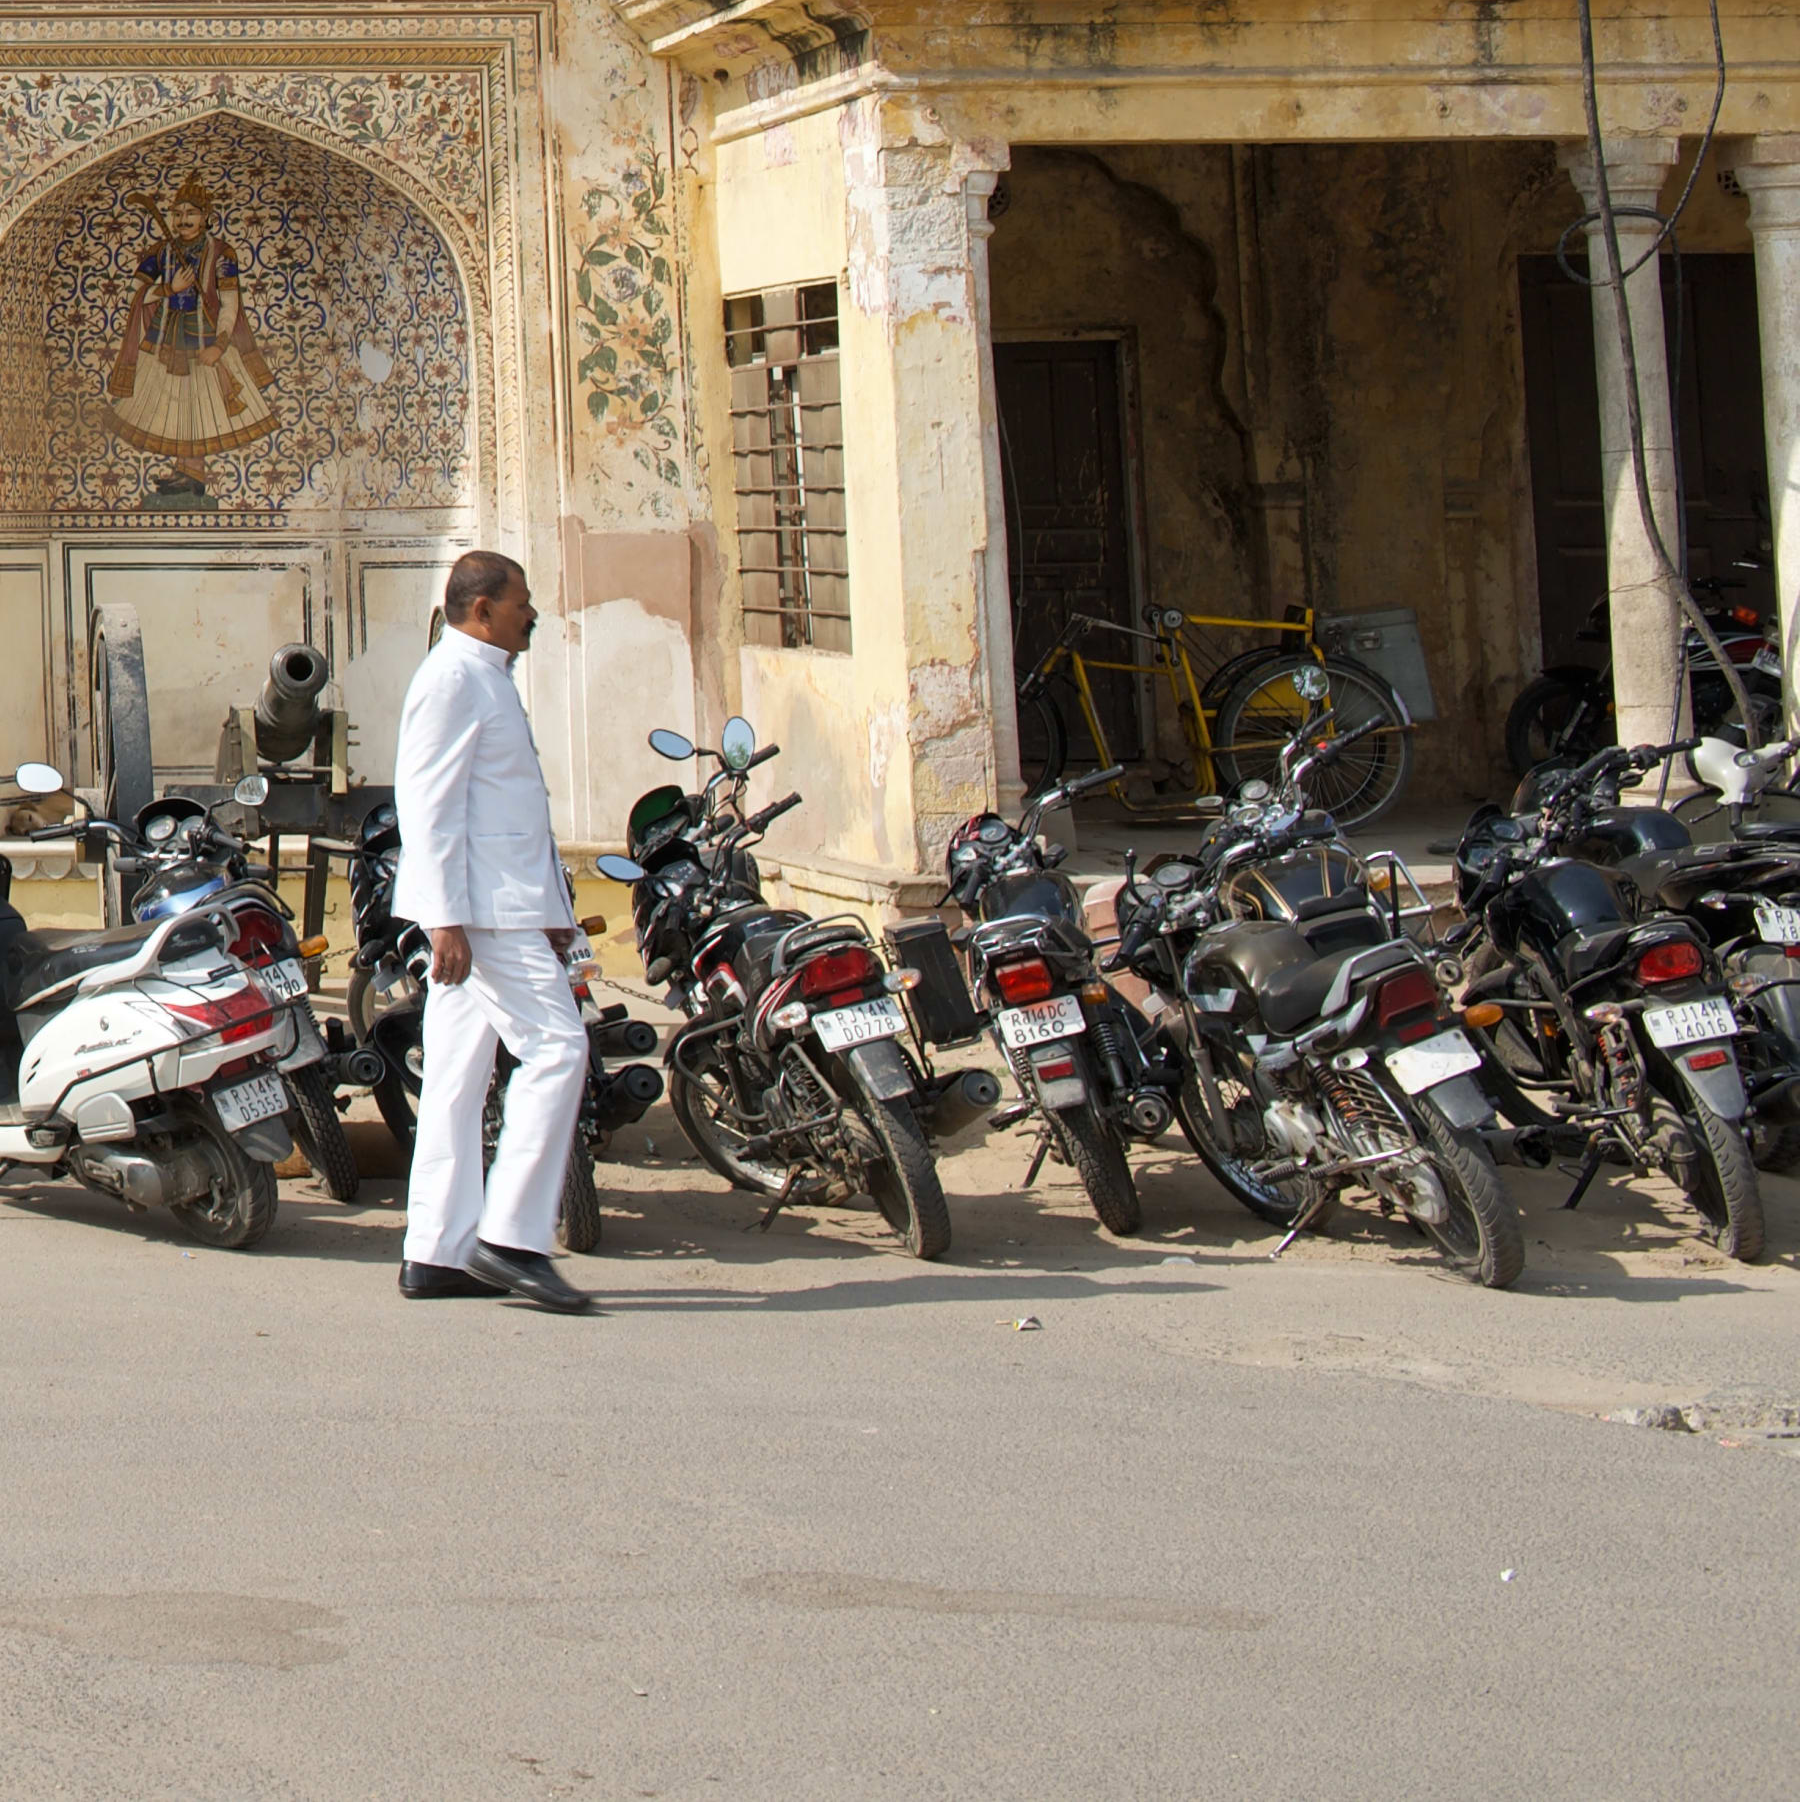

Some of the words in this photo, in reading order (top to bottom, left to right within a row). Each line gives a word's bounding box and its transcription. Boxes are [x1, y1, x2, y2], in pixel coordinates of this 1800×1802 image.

[1665, 1000, 1721, 1026] RJ14H
[1674, 1018, 1728, 1042] A4016
[230, 1075, 277, 1106] RJ14K
[240, 1092, 284, 1123] D5355
